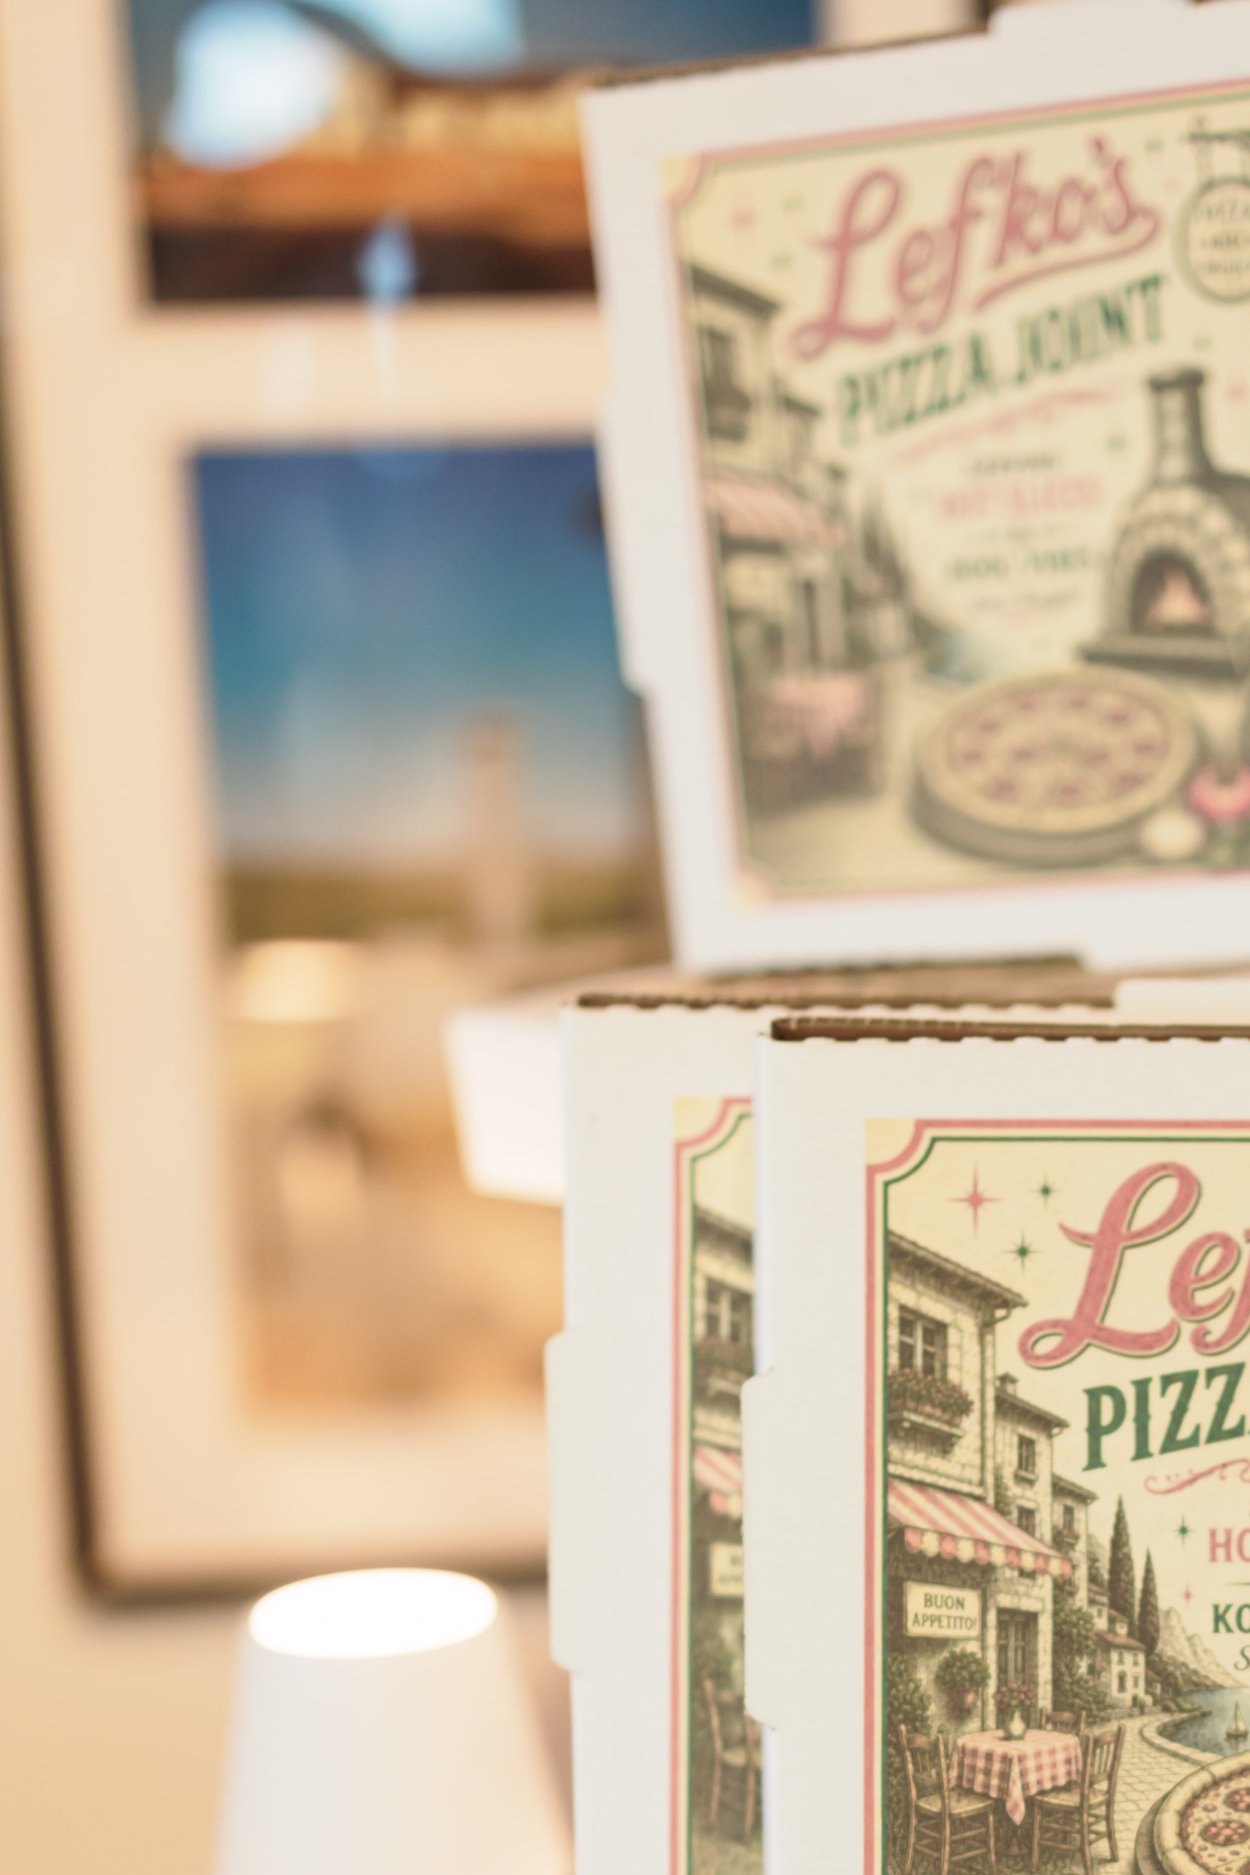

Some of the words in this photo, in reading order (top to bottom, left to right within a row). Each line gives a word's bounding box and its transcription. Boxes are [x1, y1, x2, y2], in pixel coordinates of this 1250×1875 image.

[790, 134, 1162, 362] Lefko's
[838, 332, 994, 448] PIZZA
[1014, 274, 1168, 386] JOINT
[911, 1612, 977, 1631] APPETITO!
[923, 1592, 965, 1610] BUON
